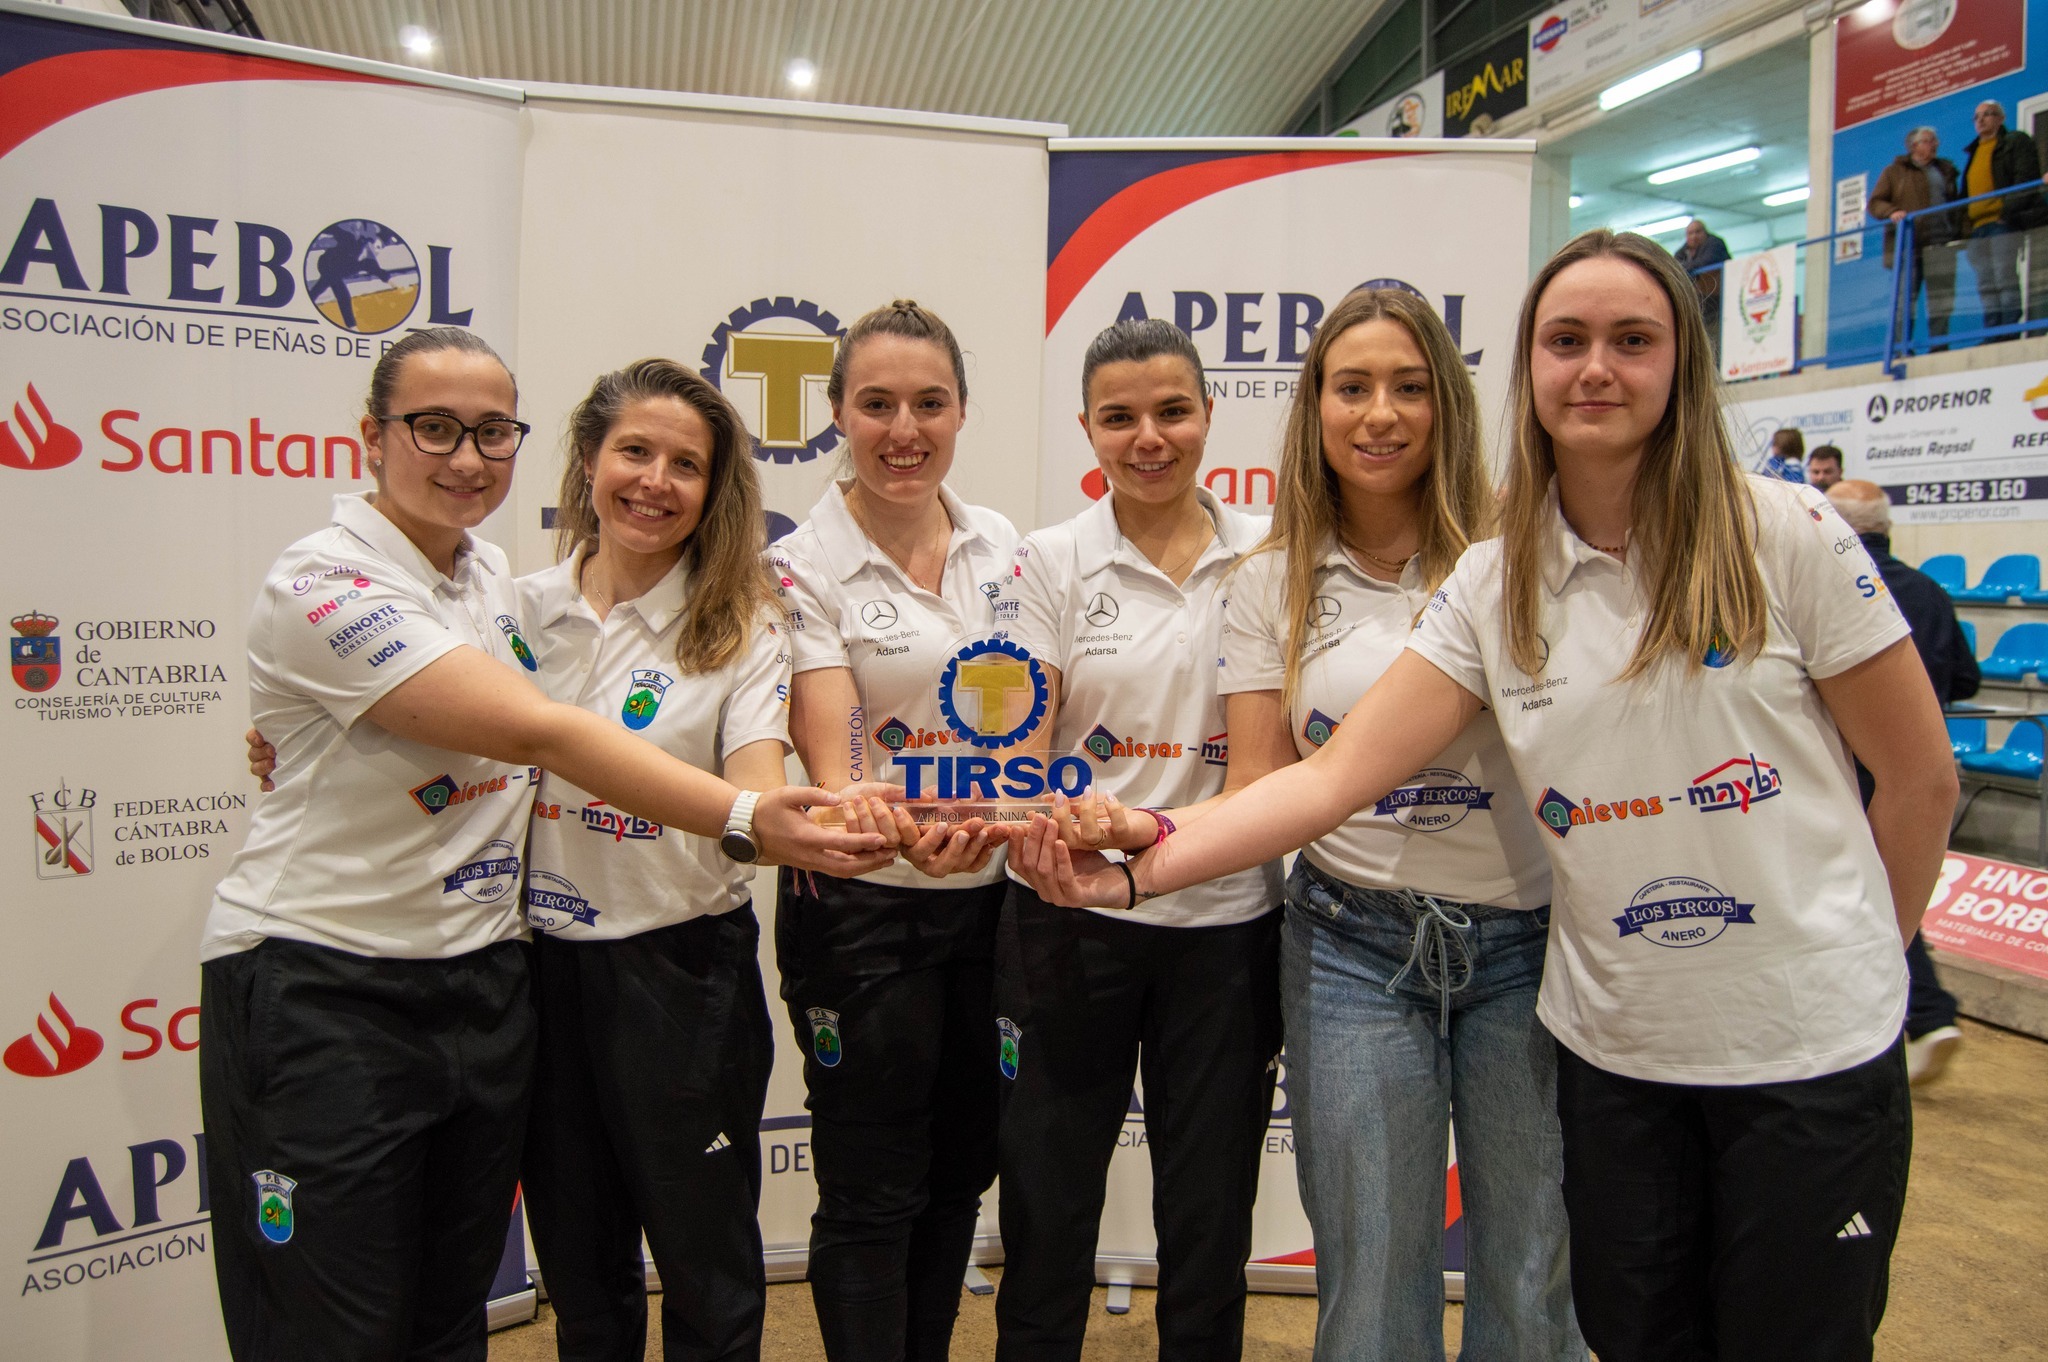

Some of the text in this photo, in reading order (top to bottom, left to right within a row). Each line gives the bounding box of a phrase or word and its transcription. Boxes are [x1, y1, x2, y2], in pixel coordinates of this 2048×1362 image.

[0, 307, 175, 344] SOCIACIÓN
[186, 324, 225, 348] DE
[235, 326, 326, 355] PEÑAS
[336, 335, 371, 359] DE
[1236, 381, 1266, 398] DE
[1893, 388, 1992, 415] PROPENOR
[1906, 479, 2027, 504] 942 526 160
[75, 619, 216, 641] GOBIERNO
[329, 604, 398, 650] ASENORTE
[338, 614, 405, 657] CONSULTORES
[76, 645, 101, 664] de
[367, 640, 407, 667] LUCÍA
[875, 645, 910, 656] Adarsa
[1085, 647, 1117, 656] Adarsa
[76, 664, 228, 687] CANTABRIA
[644, 672, 662, 682] P.B.
[1502, 675, 1568, 698] Mercedes-Benz
[15, 691, 222, 710] CONSEJERÍA DE CULTURA
[1521, 695, 1553, 712] Adarsa
[37, 703, 205, 721] TURISMO Y DEPORTE
[850, 706, 863, 782] CAMPEÓN
[892, 756, 1093, 799] TIRSO
[113, 792, 247, 818] FEDERACIÓN
[1388, 788, 1478, 806] LOS ARCOS
[918, 812, 962, 822] APEBOL
[969, 811, 1028, 822] FEMENINA
[1409, 814, 1450, 826] ANERO
[114, 820, 228, 842] CÁNTABRA
[116, 843, 210, 866] de BOLOS
[458, 864, 484, 882] LOS
[477, 883, 503, 896] ANERO
[1639, 880, 1711, 900] CAFETERÍA RESTAURANTE
[534, 892, 586, 913] ARCOS
[1629, 899, 1734, 924] LOS ARCOS
[1661, 926, 1706, 941] ANERO
[2005, 936, 2025, 947] DE
[771, 1143, 810, 1174] DE
[21, 1233, 206, 1297] ASOCIACIÓN
